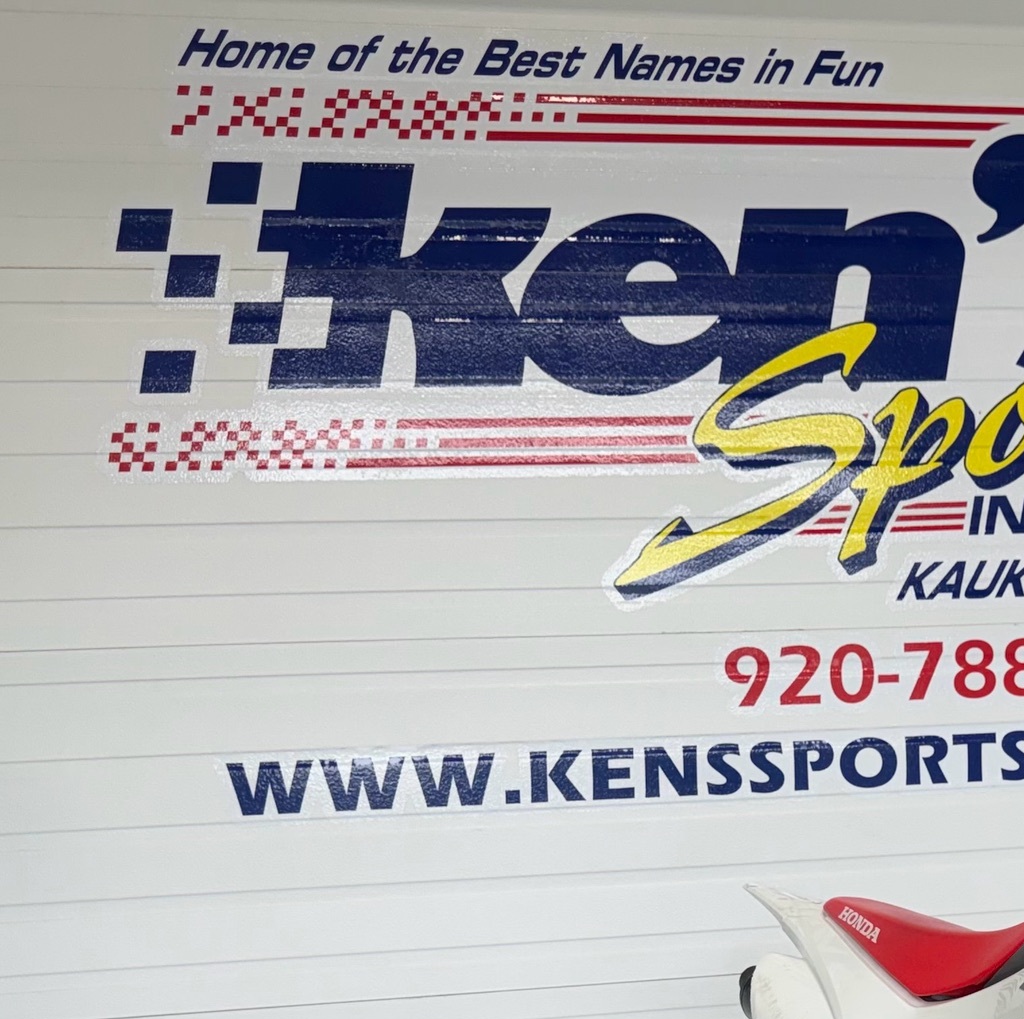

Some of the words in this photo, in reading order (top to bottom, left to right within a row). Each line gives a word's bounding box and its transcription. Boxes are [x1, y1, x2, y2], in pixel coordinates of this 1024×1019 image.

[178, 28, 315, 70] Home
[328, 35, 384, 73] of
[390, 39, 464, 75] the
[473, 39, 586, 80] Best
[593, 43, 745, 85] Names
[752, 48, 795, 84] in
[804, 50, 885, 88] Fun
[838, 906, 881, 944] HONDA
